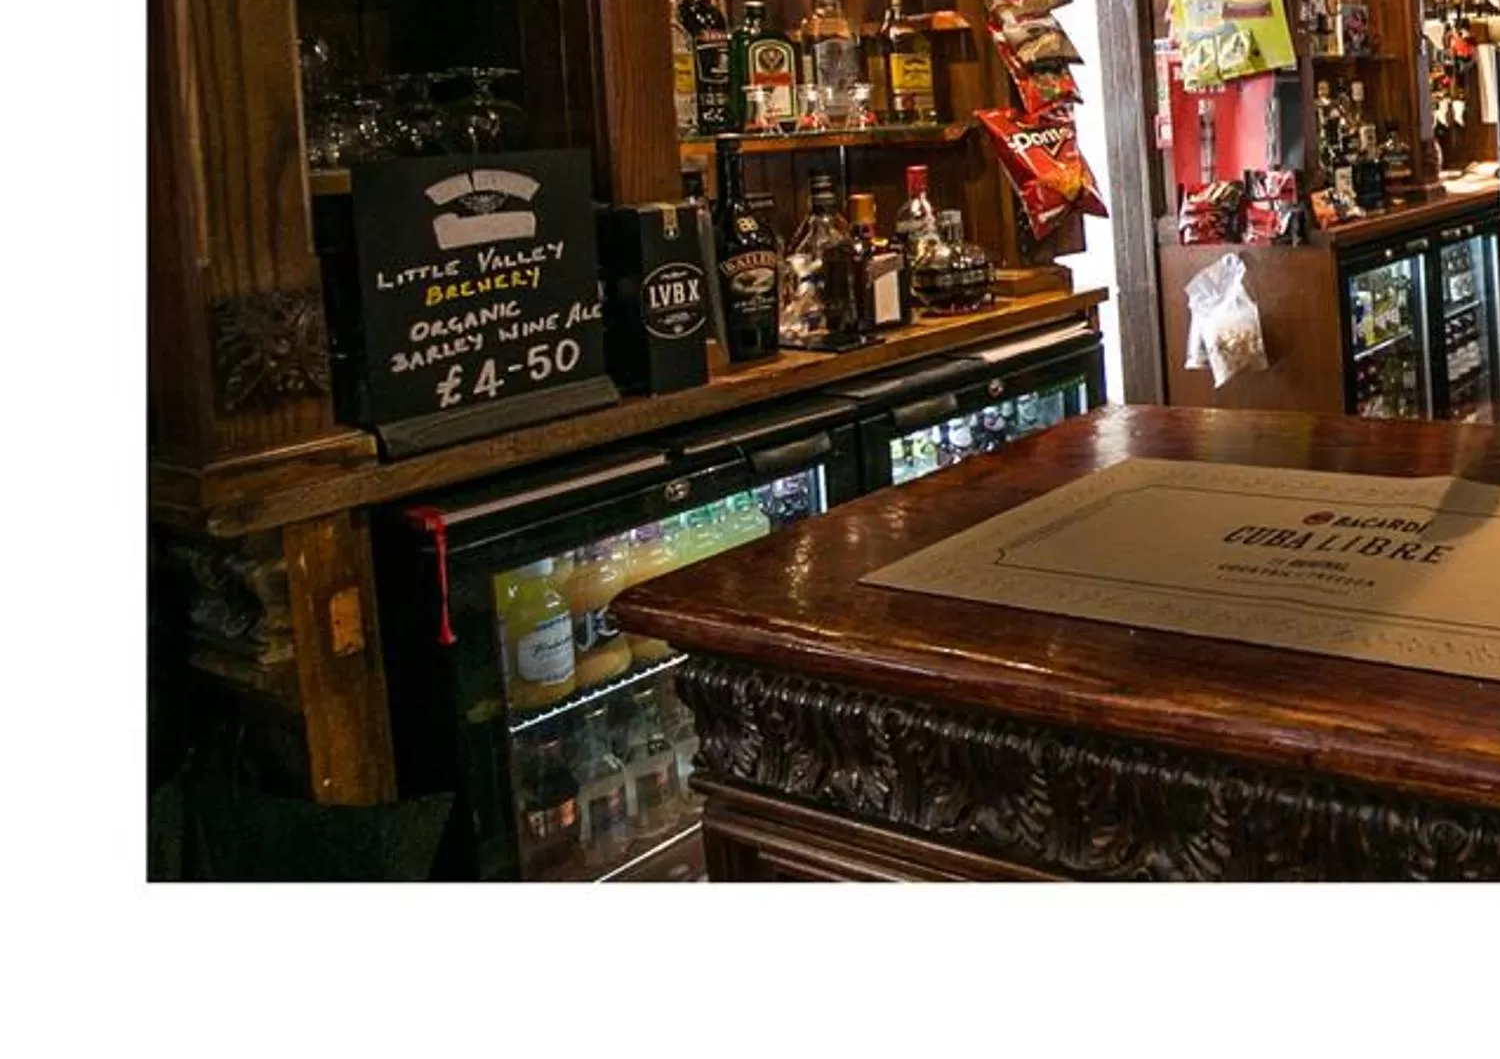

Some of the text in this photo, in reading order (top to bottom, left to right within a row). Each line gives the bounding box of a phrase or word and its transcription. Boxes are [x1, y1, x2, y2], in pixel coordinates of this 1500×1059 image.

[376, 240, 565, 290] LITTLE VALLEY
[424, 267, 541, 307] BREWERY
[389, 301, 604, 373] BARLEY WINE ALE
[410, 300, 521, 342] ORGANIC
[1223, 524, 1454, 564] CUBA LIBRE
[1331, 515, 1433, 534] BACARDI
